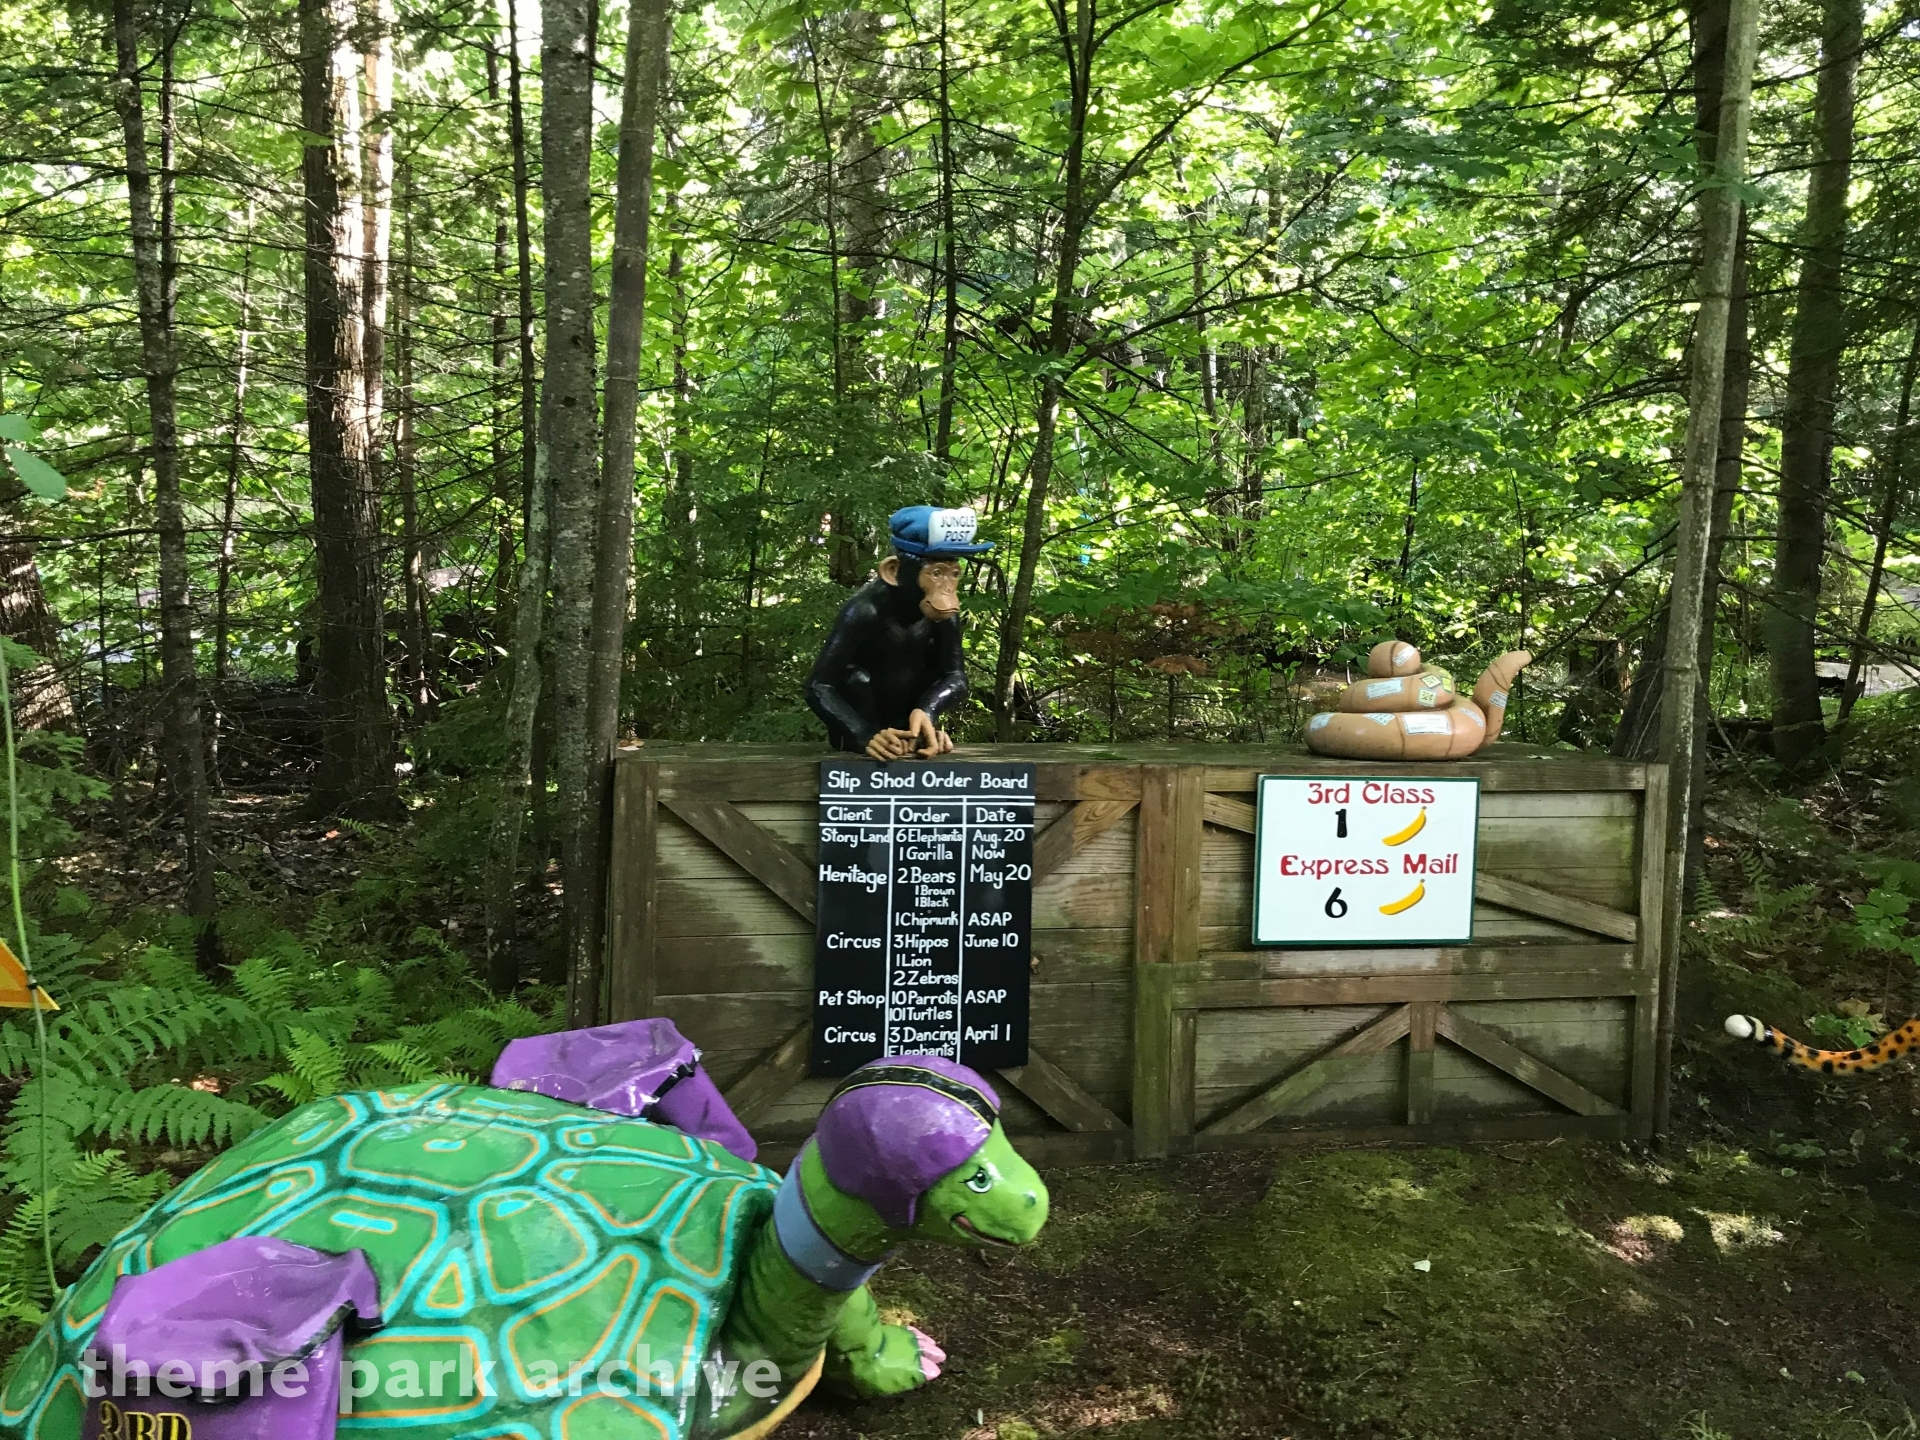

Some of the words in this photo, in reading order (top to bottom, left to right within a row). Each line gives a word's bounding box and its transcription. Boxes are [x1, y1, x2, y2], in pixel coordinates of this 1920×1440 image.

[940, 516, 974, 527] JUNGLE
[944, 531, 970, 541] POST
[827, 771, 861, 792] Slip
[870, 771, 915, 789] Shod
[921, 771, 972, 788] Order
[980, 773, 1028, 789] Board
[1308, 783, 1350, 804] 3rd
[1362, 783, 1435, 804] Class
[827, 806, 873, 821] Client
[899, 807, 950, 822] Order
[975, 807, 1016, 822] Date
[1335, 809, 1347, 838] 1
[821, 828, 858, 847] Story
[896, 829, 907, 843] 6
[908, 829, 963, 848] Elephants
[973, 830, 1001, 848] Aug.
[1004, 829, 1025, 842] 20
[907, 844, 953, 861] Gorilla
[972, 845, 1005, 859] Now
[910, 866, 956, 884] Bears
[1281, 855, 1389, 880] Express
[1404, 853, 1458, 874] Mail
[819, 864, 887, 893] Heritage
[970, 864, 1003, 889] May
[1005, 864, 1032, 881] 20
[1325, 887, 1348, 918] 6
[968, 912, 1012, 926] ASAP
[827, 932, 881, 949] Circus
[964, 934, 999, 948] June
[1002, 933, 1018, 947] 10
[902, 954, 932, 967] Lion
[908, 971, 959, 986] Zebras
[819, 991, 843, 1006] Pet
[847, 990, 885, 1009] Shop
[908, 990, 958, 1005] Parrots
[964, 989, 1007, 1004] ASAP
[824, 1026, 876, 1043] Circus
[889, 1027, 900, 1043] 3
[903, 1025, 958, 1045] Dancing
[964, 1024, 998, 1046] April
